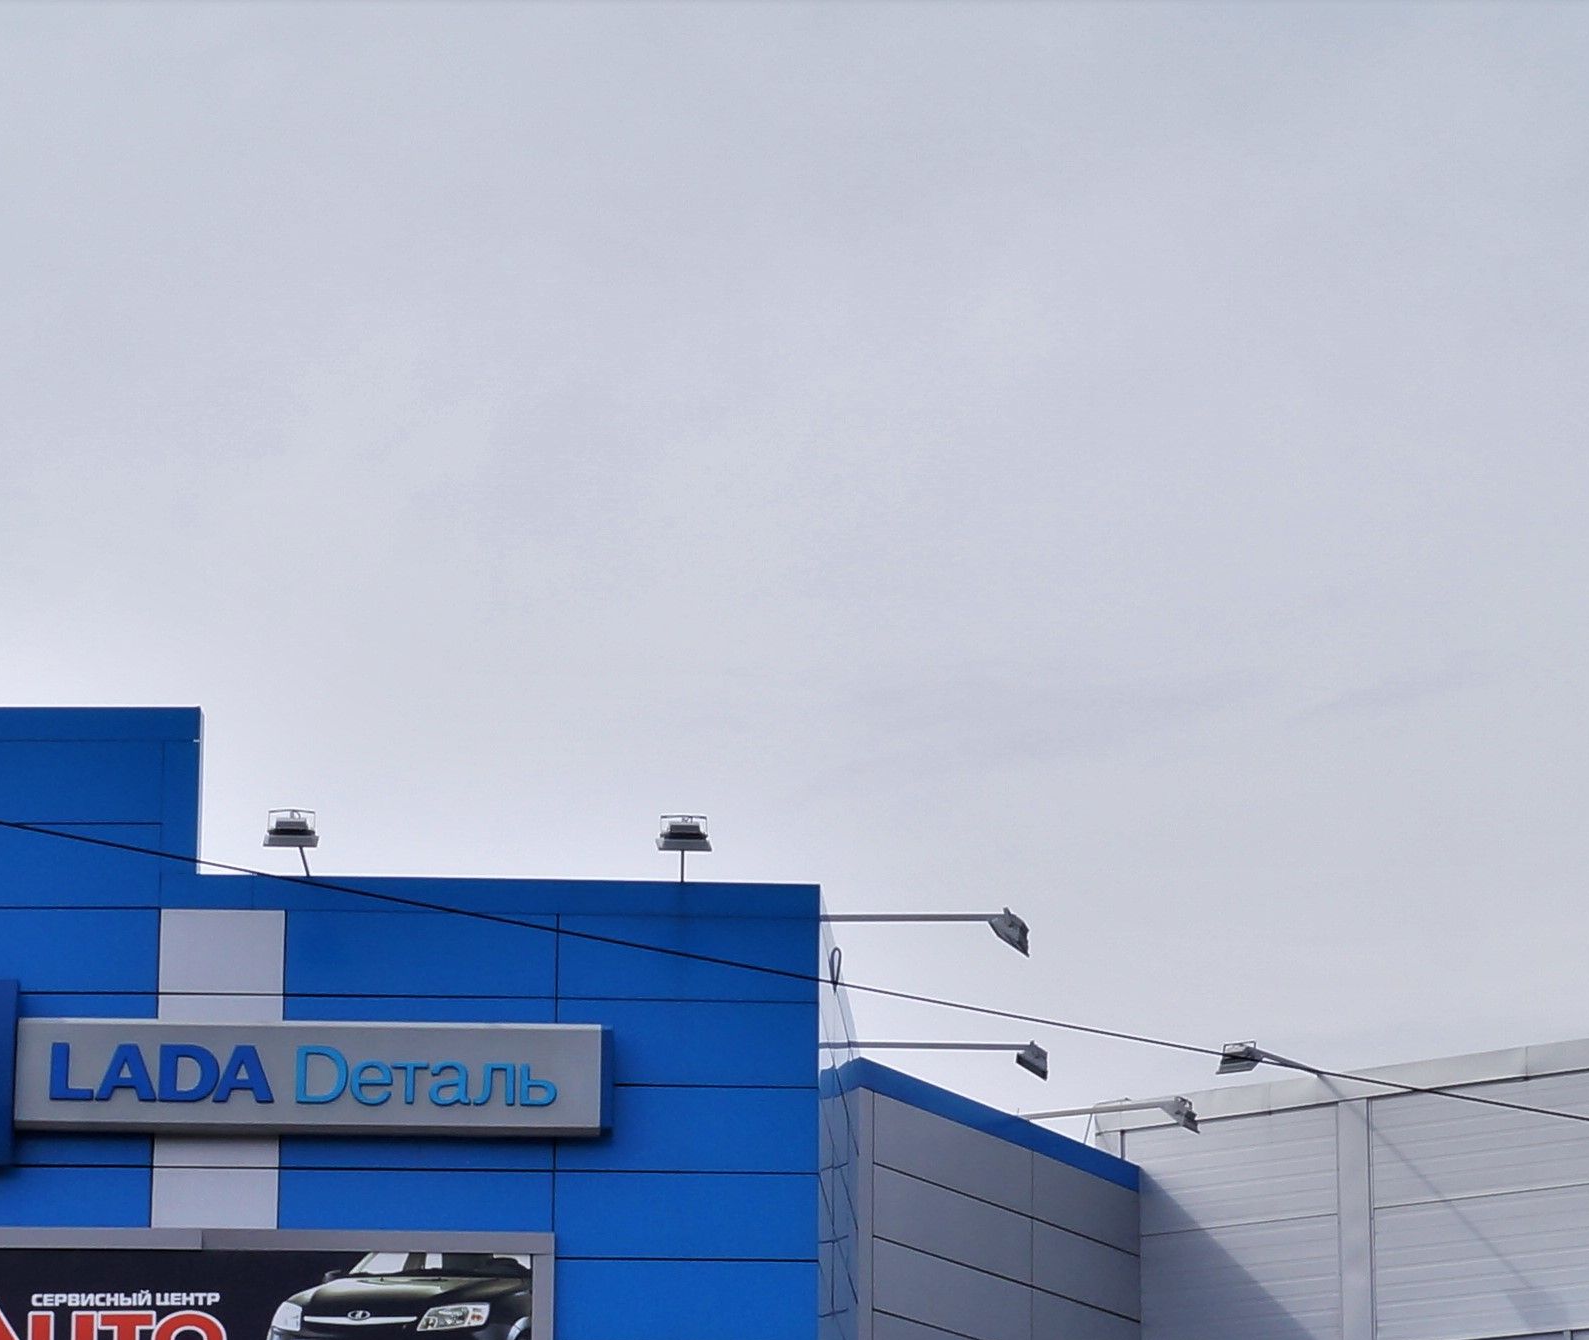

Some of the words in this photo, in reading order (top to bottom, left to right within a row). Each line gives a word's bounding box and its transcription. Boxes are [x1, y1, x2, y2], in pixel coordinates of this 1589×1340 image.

[49, 1042, 276, 1103] LADA
[30, 1289, 152, 1307] СЕРВИСНЫЙ
[155, 1291, 221, 1306] ЦЕНТР
